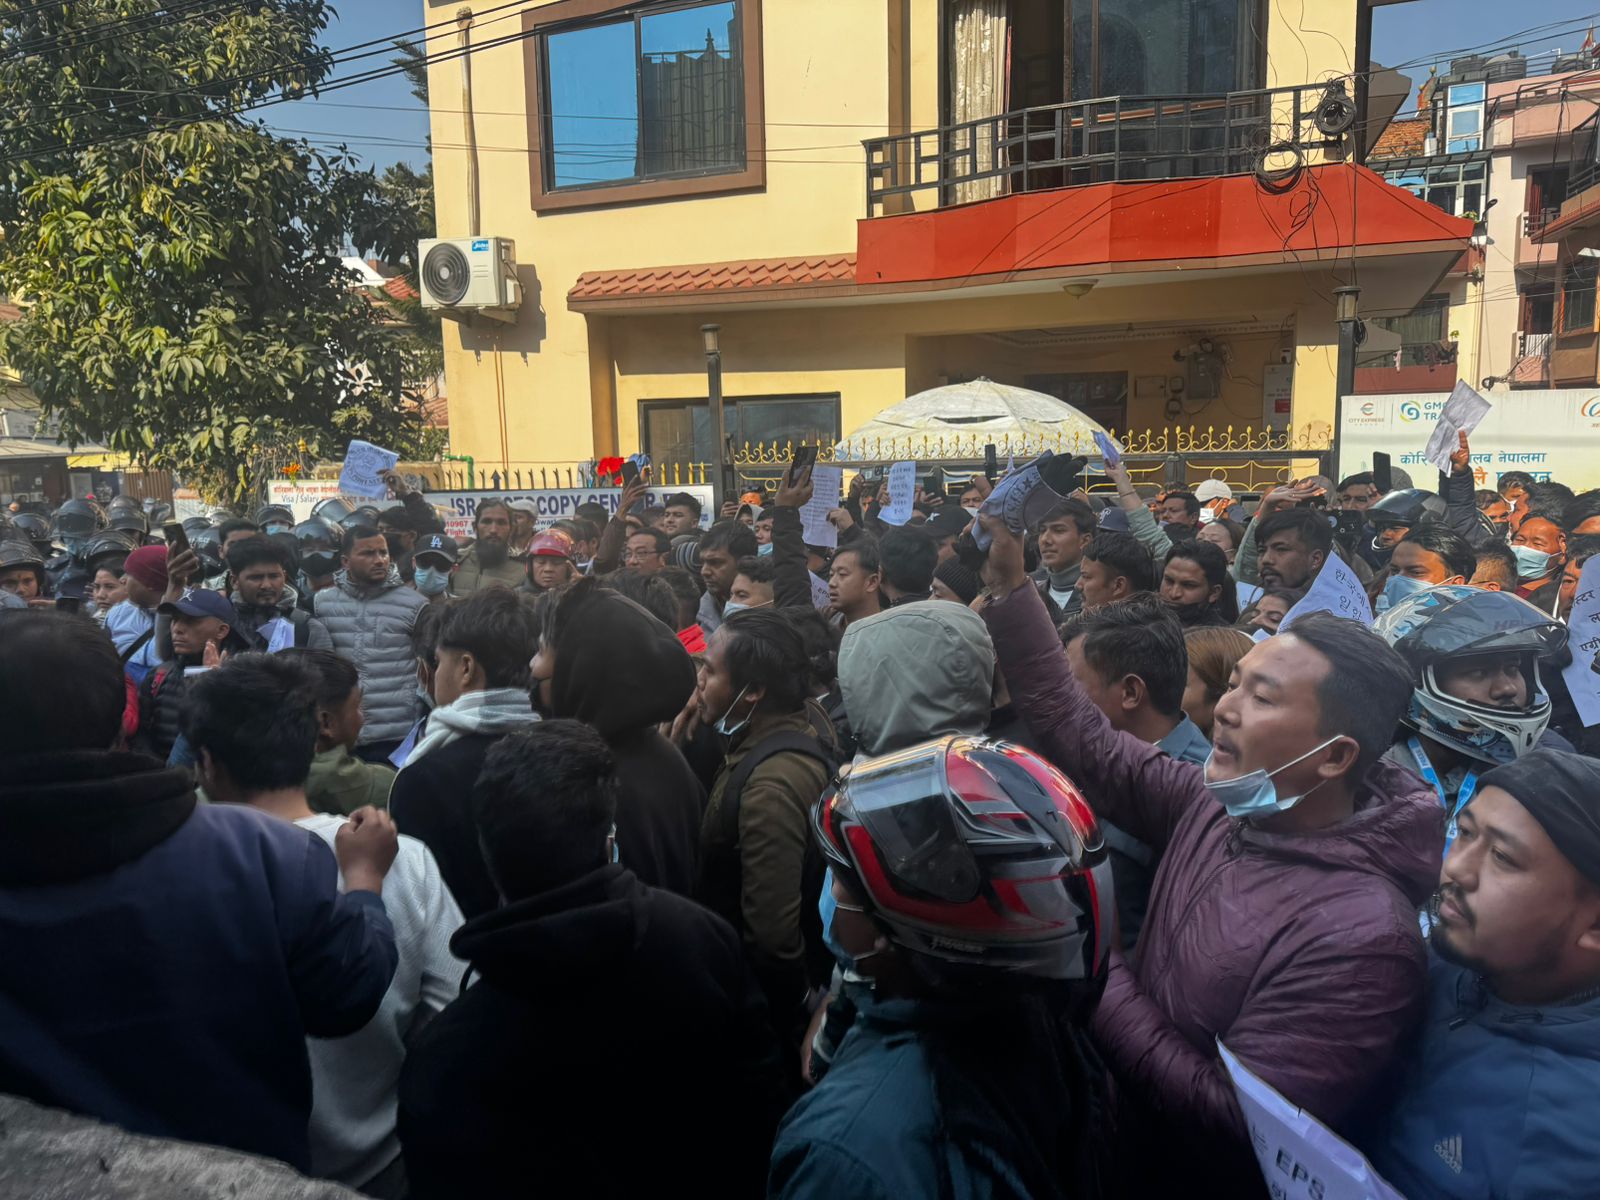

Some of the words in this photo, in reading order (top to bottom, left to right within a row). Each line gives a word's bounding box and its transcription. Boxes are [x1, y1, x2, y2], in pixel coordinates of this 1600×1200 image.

[1400, 451, 1428, 465] कोरि
[1498, 450, 1548, 465] नेपालमा
[282, 495, 295, 503] Visa
[300, 495, 319, 504] Salary
[431, 535, 442, 548] LA
[1335, 568, 1366, 607] 한국에
[1573, 589, 1596, 608] स्टर
[1433, 1144, 1462, 1174] adidas
[1275, 1148, 1326, 1200] EPS
